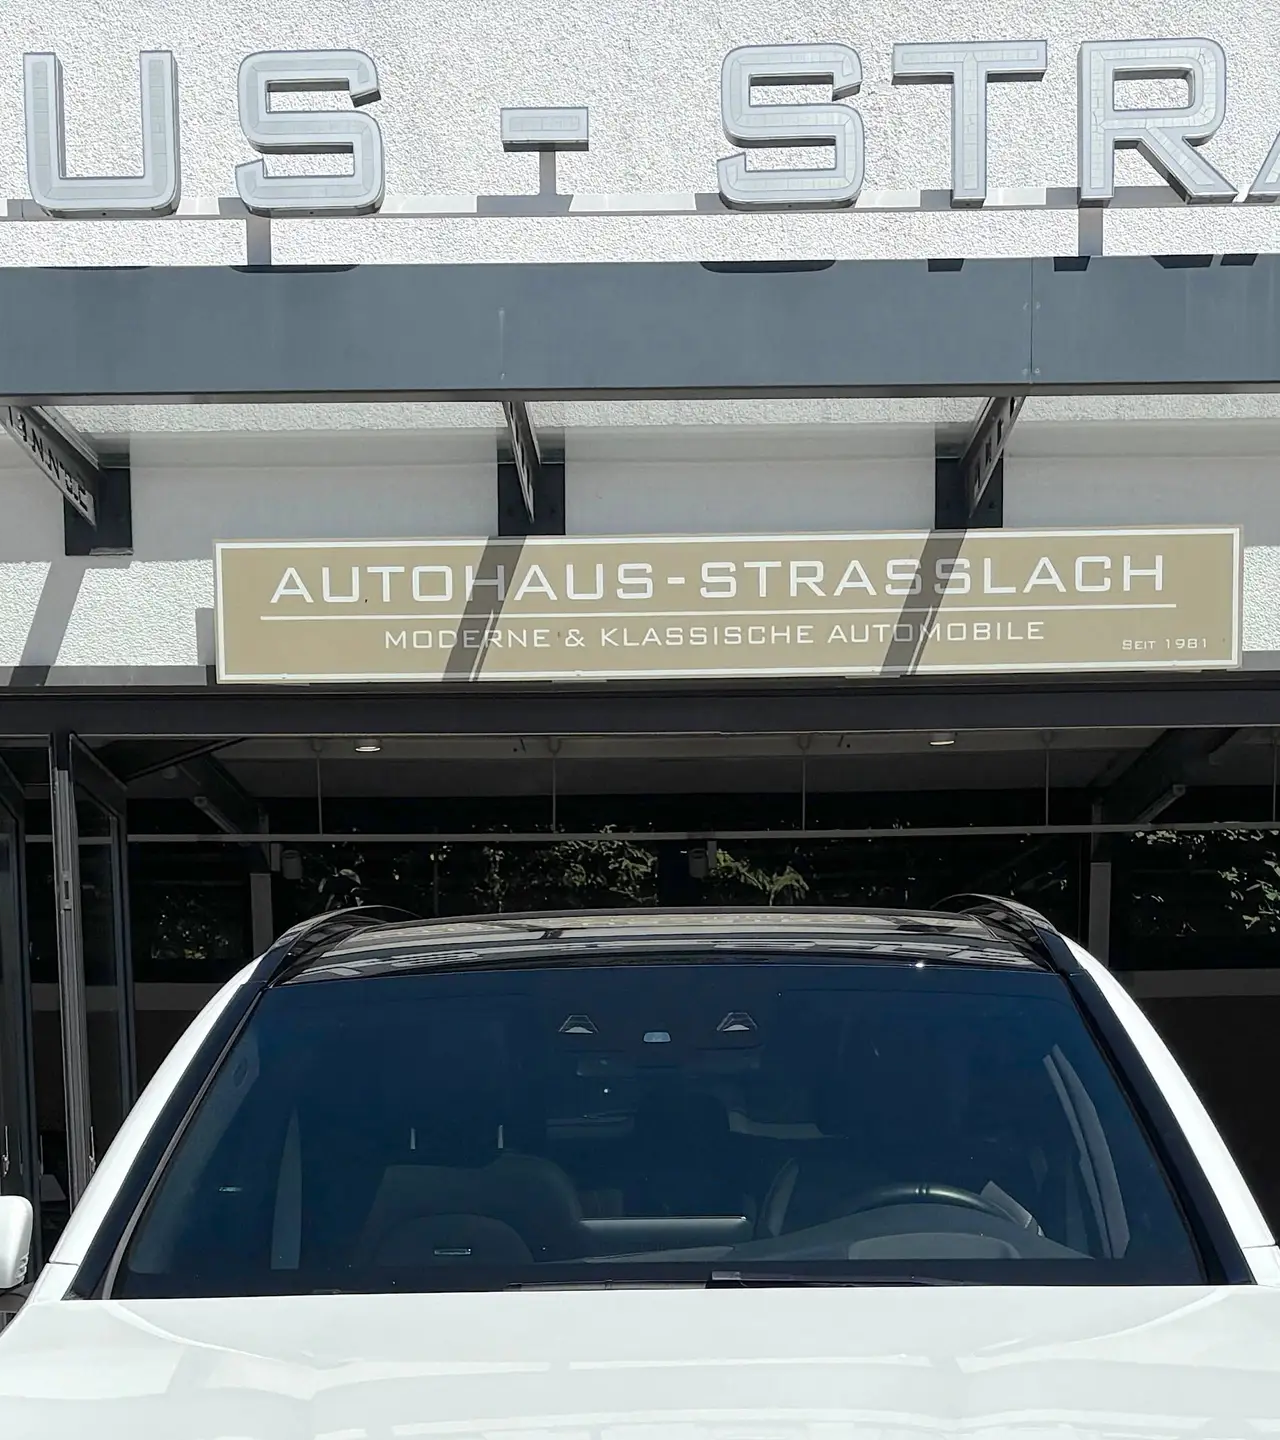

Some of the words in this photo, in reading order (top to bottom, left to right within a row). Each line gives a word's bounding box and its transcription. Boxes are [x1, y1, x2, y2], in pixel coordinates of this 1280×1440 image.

[383, 628, 551, 650] MODERNE
[563, 627, 586, 648] &
[600, 624, 815, 646] KLASSISCHE
[826, 620, 1045, 645] AUTOMOBILE
[1165, 637, 1207, 650] 1981
